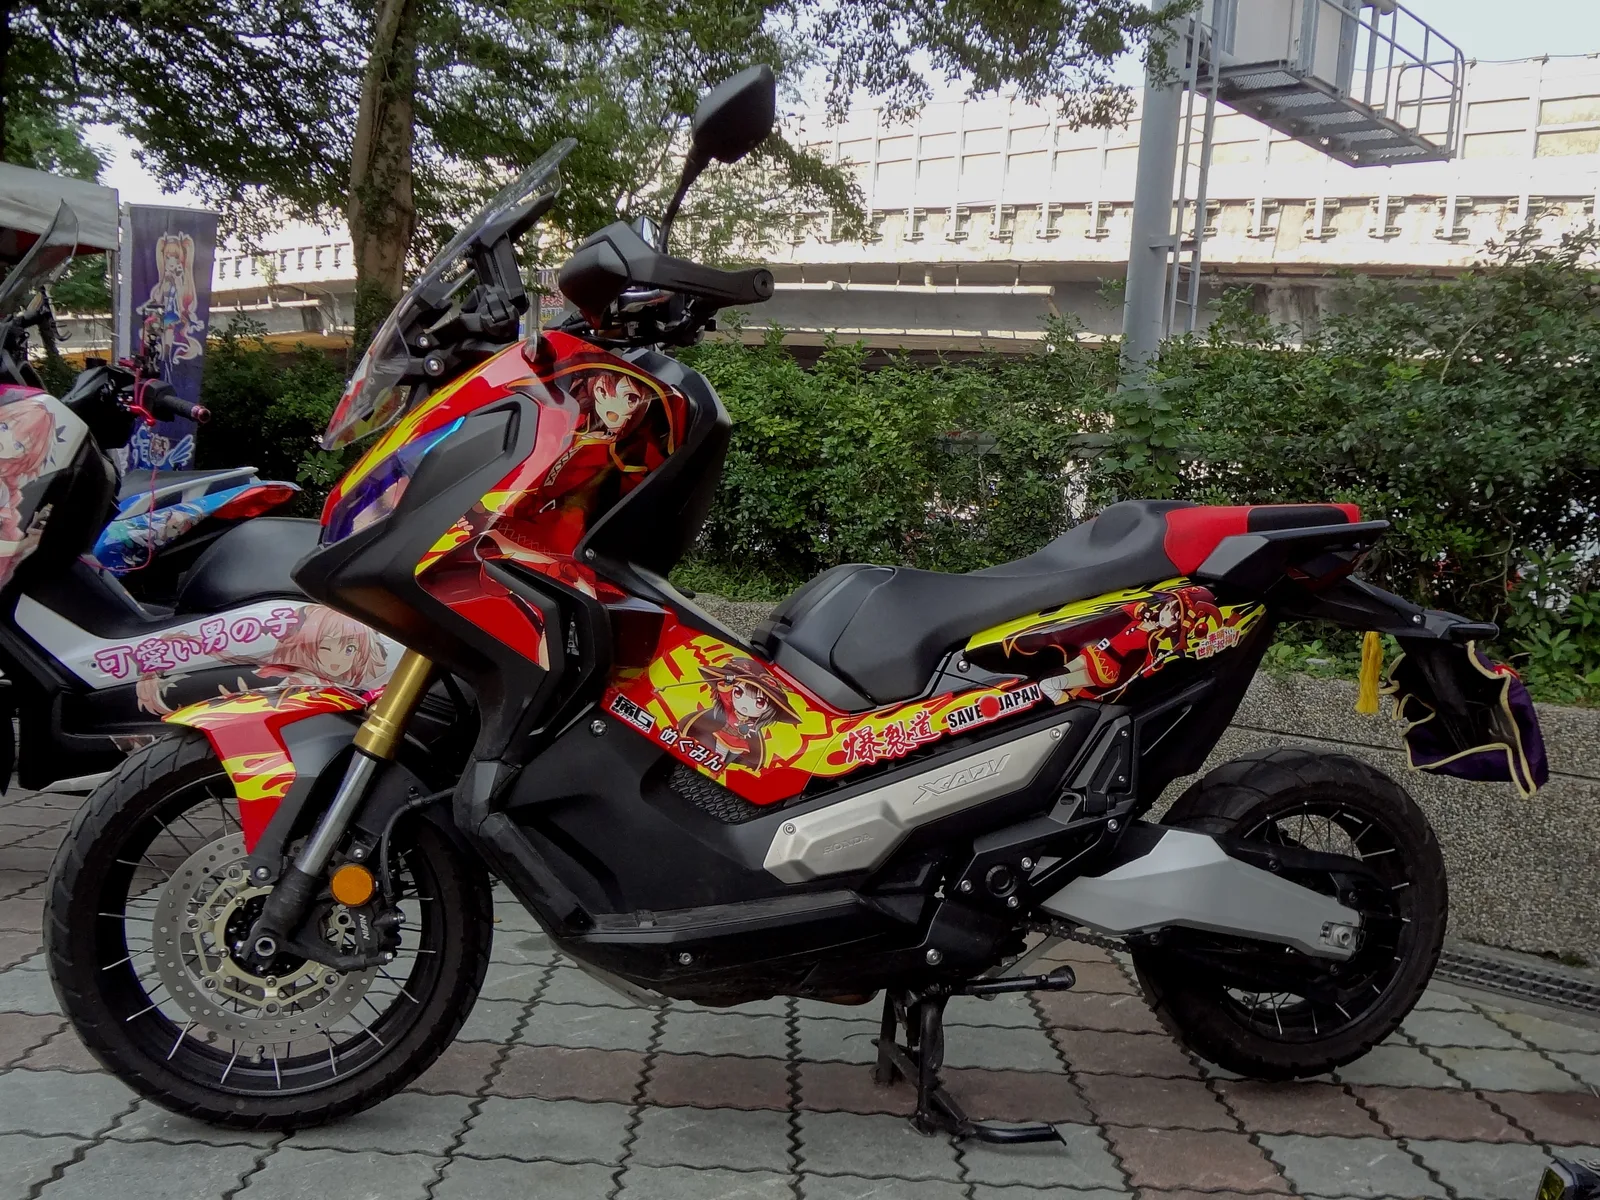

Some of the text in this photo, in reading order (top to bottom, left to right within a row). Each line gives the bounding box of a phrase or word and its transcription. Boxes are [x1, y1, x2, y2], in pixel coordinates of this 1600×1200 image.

[95, 607, 299, 678] 可愛い男の子
[947, 704, 984, 728] SAVE
[999, 685, 1040, 711] JAPAN
[659, 727, 723, 772] めぐみん
[842, 710, 941, 764] 爆裂道
[823, 832, 875, 855] HONDA
